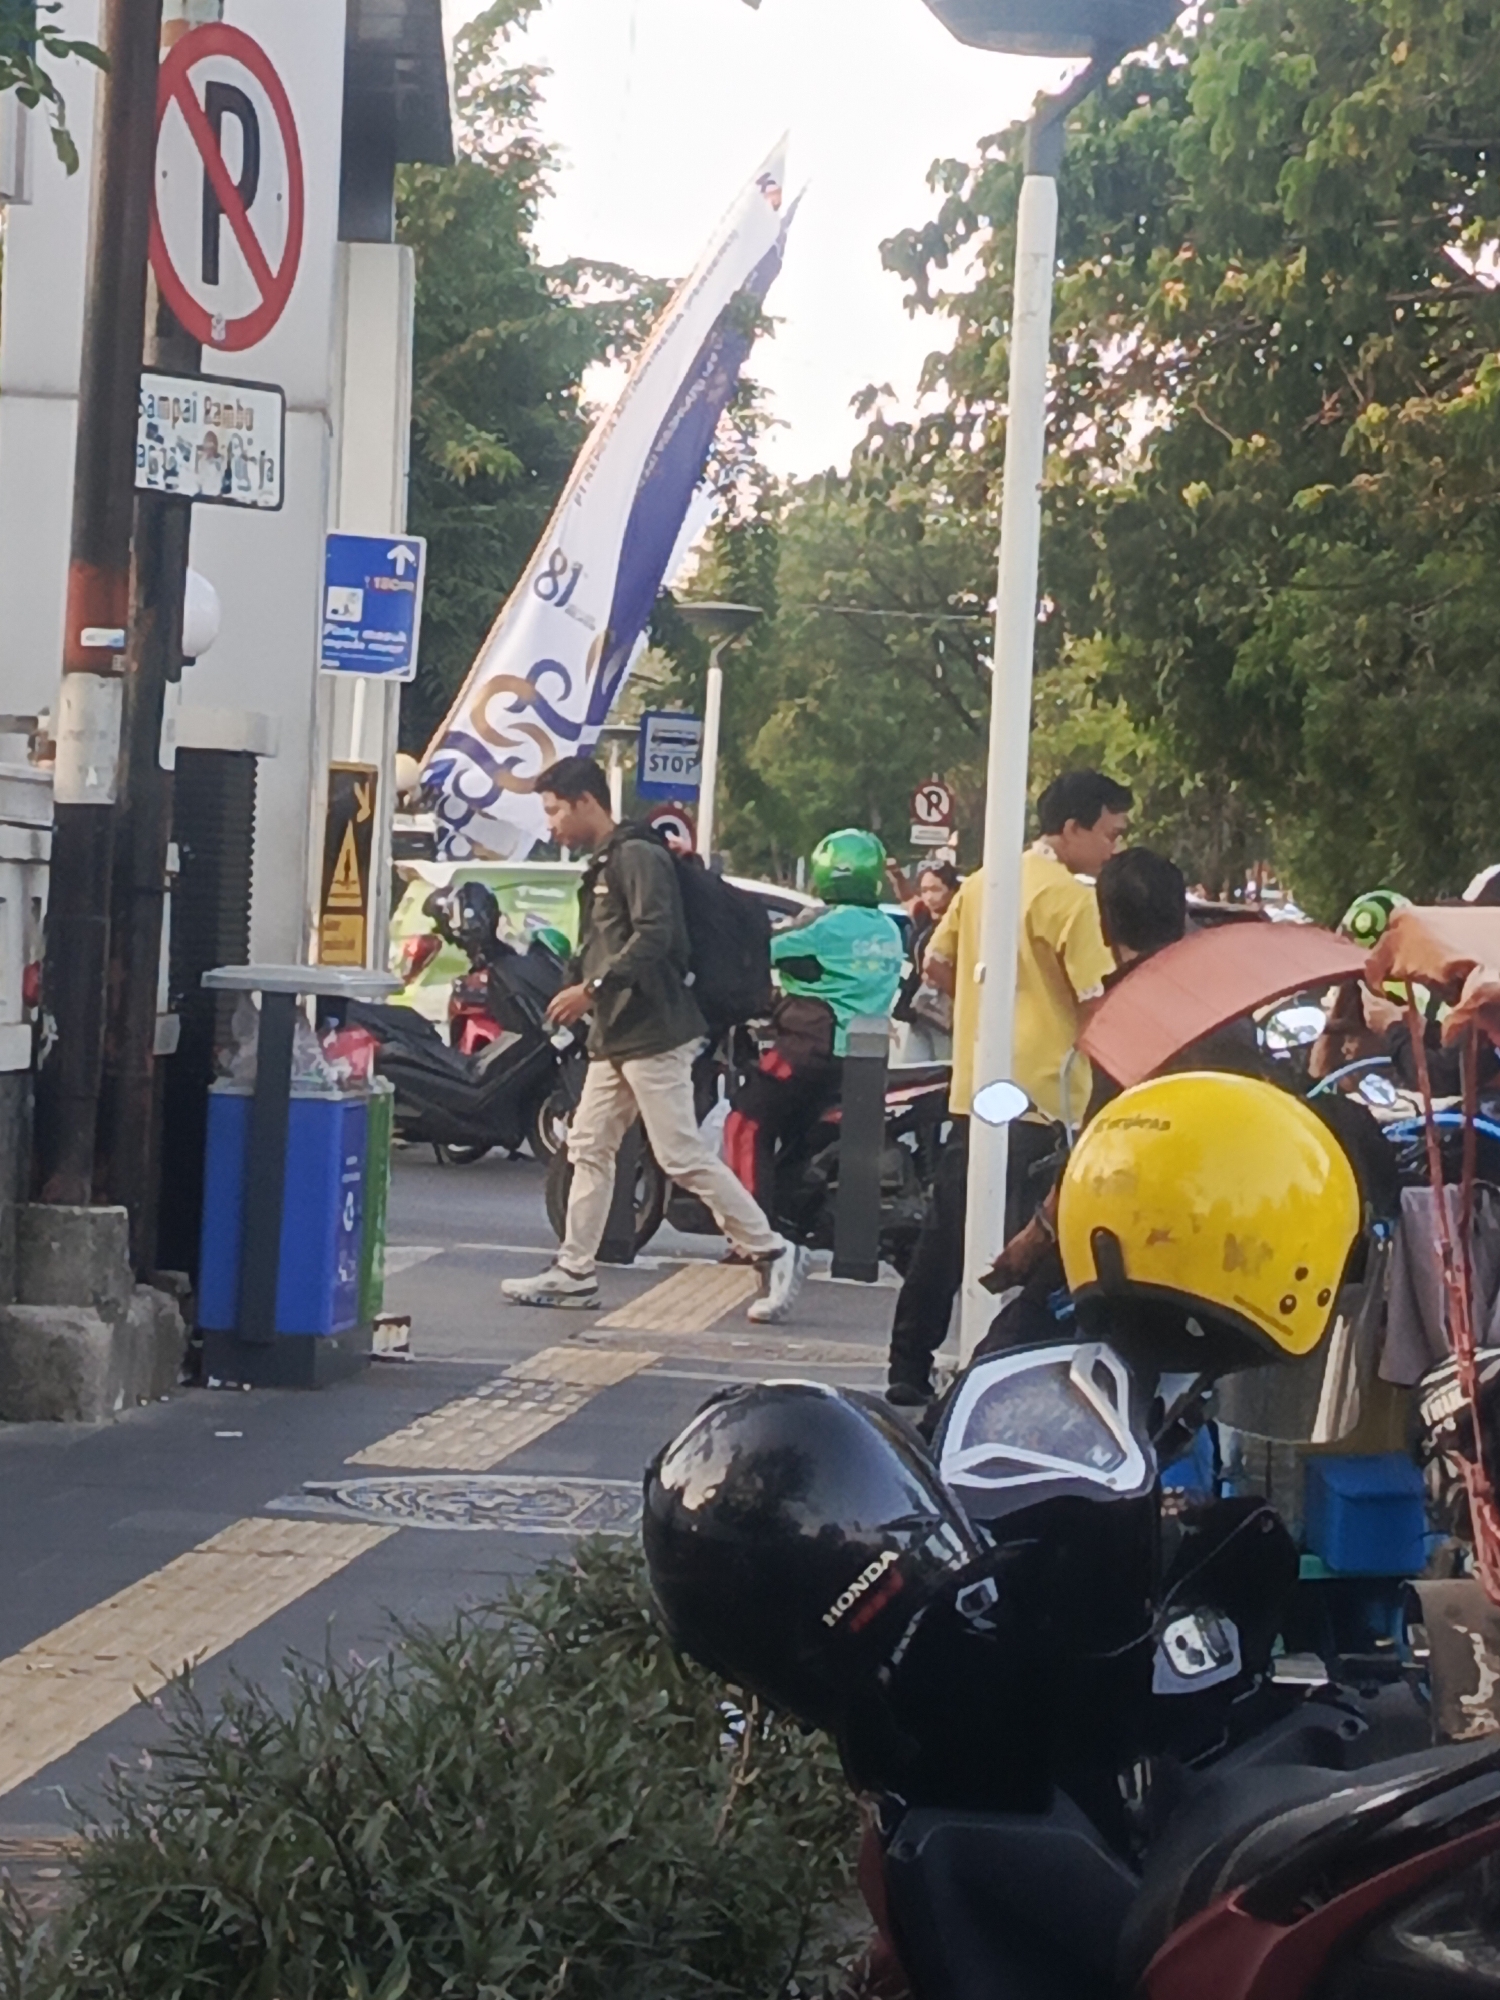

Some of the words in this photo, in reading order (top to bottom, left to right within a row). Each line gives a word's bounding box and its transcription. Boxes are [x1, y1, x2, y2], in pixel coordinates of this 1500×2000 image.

[202, 80, 260, 286] P
[649, 753, 697, 775] STOP
[822, 1550, 900, 1628] HONDA
